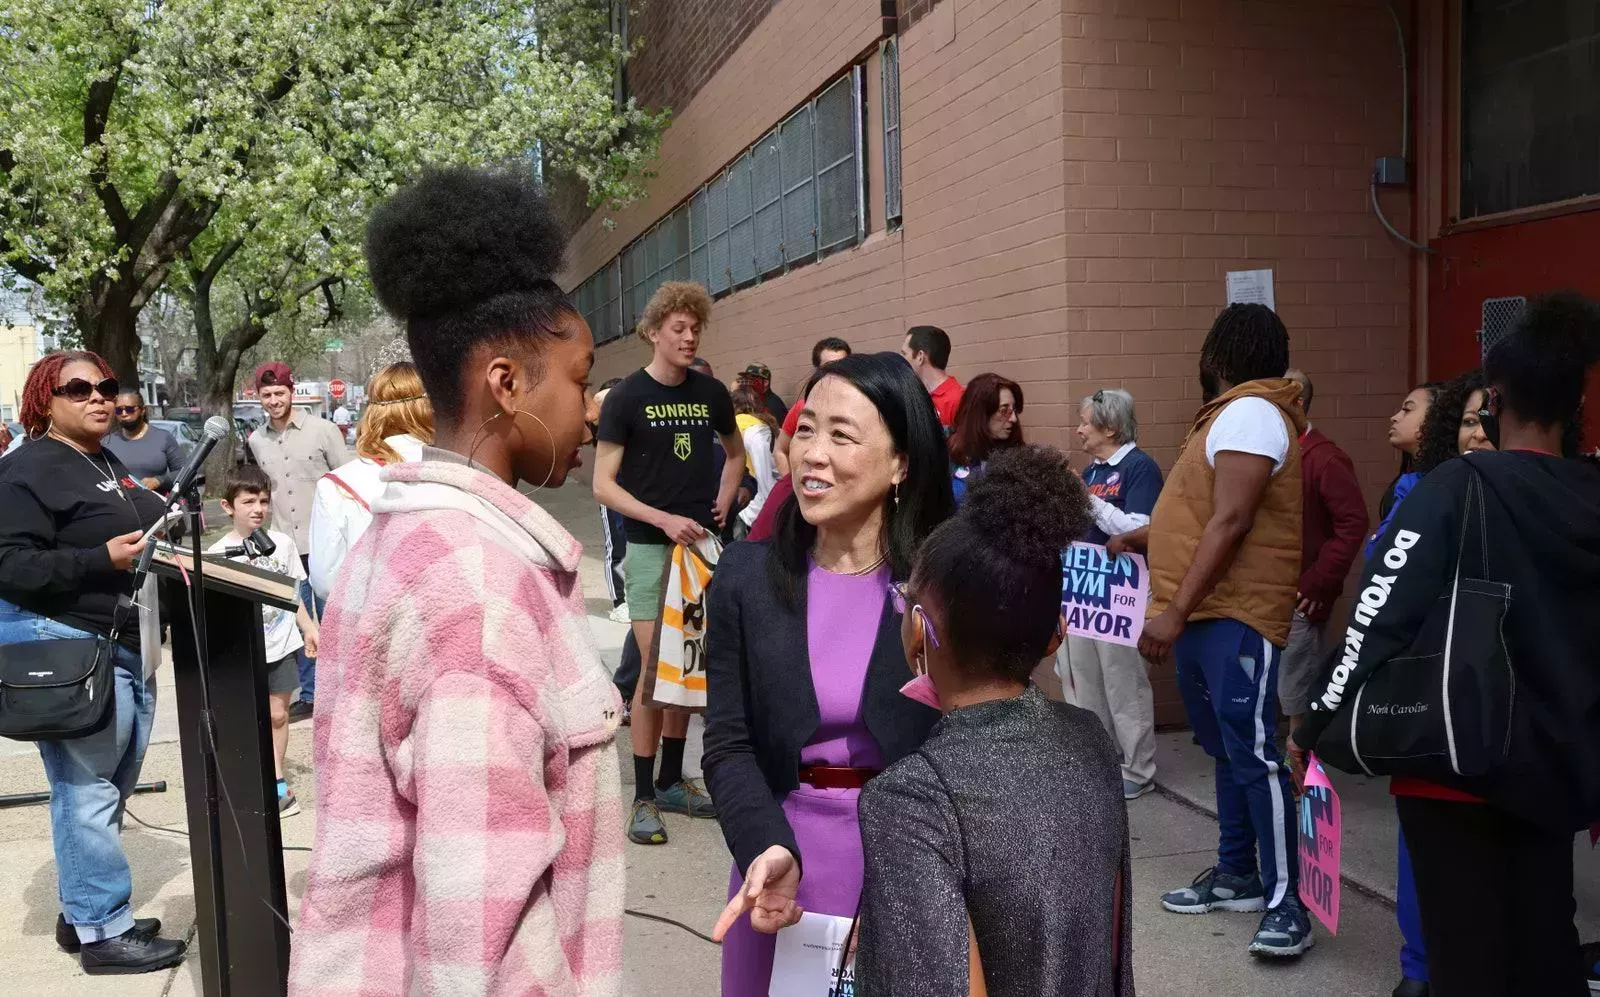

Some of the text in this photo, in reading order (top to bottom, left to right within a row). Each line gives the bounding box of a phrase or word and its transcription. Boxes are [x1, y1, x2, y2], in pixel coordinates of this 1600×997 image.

[330, 384, 345, 392] STOP
[645, 404, 709, 419] SUNRISE
[1113, 594, 1136, 607] FOR
[1062, 604, 1133, 639] AYOR
[1310, 529, 1421, 711] DO YOU KNOW
[1319, 834, 1333, 858] FOR
